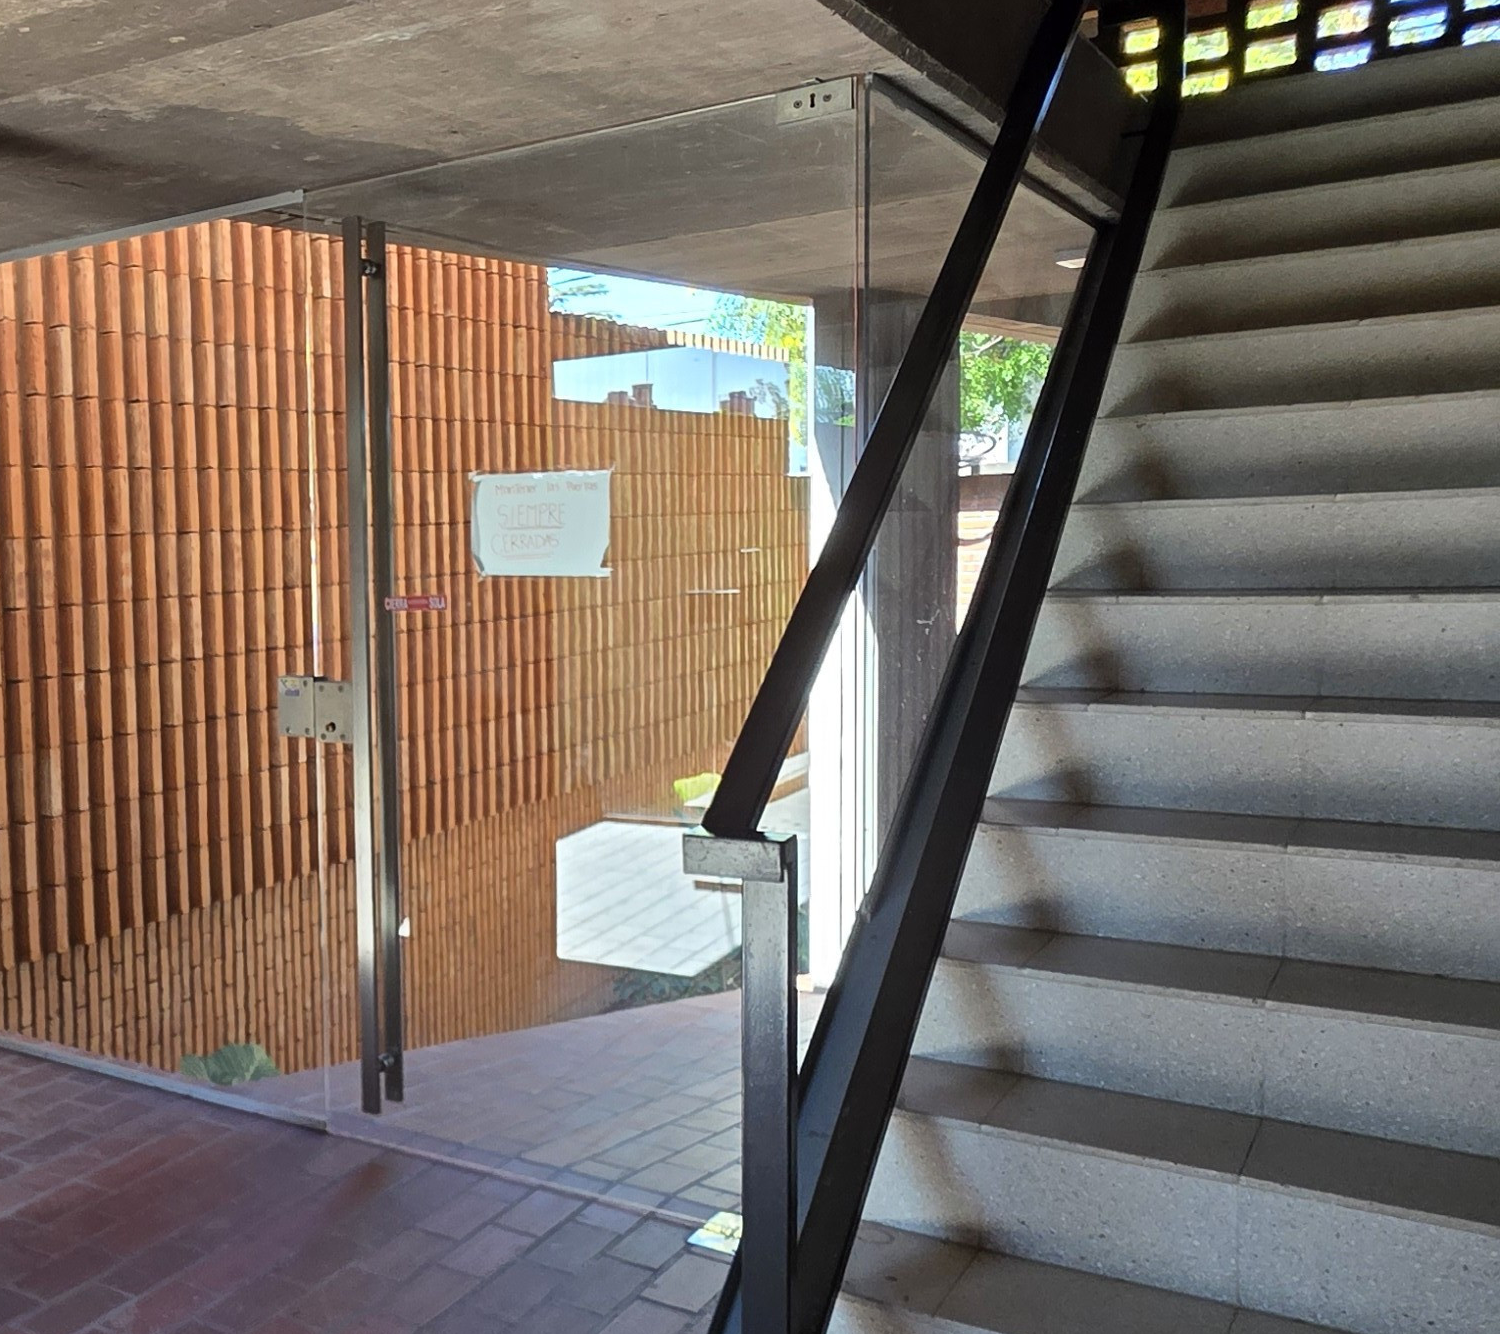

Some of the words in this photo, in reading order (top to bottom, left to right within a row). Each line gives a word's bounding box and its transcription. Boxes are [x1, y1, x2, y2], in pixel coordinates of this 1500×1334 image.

[497, 502, 566, 529] SIEMPRE
[491, 533, 560, 555] CERRADAS
[429, 596, 446, 609] SOLA
